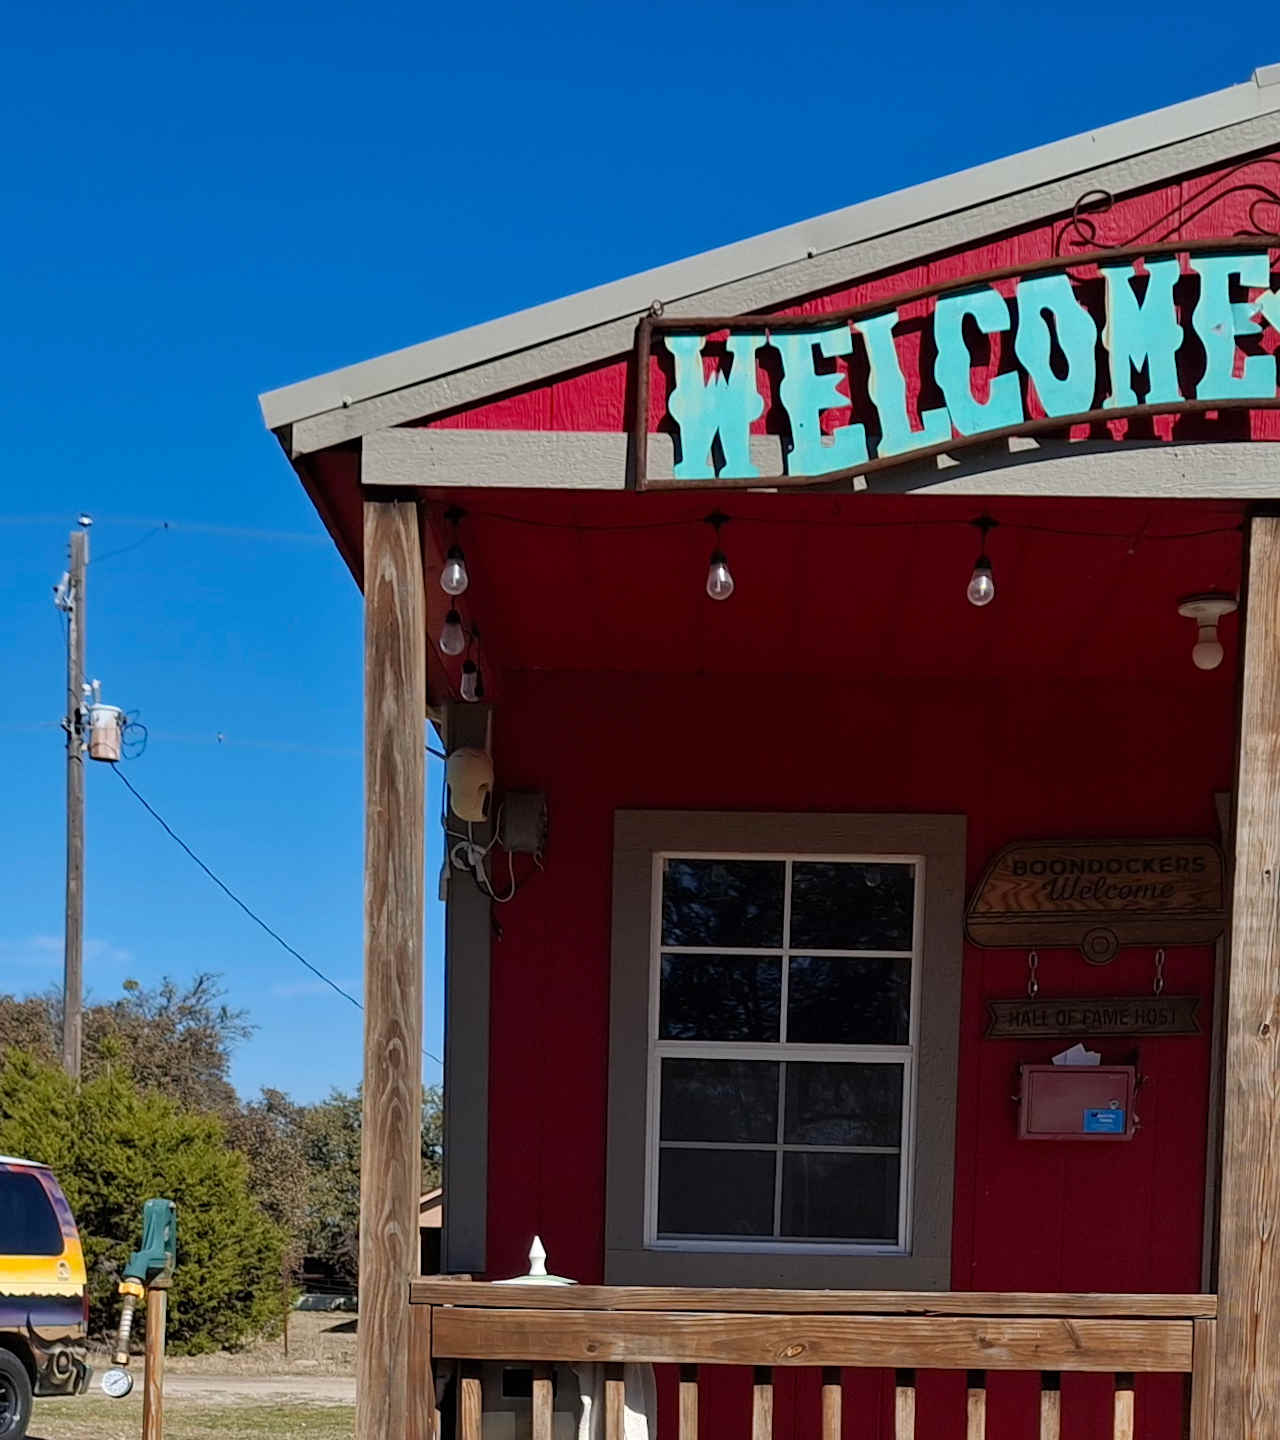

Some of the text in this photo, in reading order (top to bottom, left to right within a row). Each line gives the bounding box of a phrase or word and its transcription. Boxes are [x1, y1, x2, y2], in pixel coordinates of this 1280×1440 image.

[664, 254, 1277, 480] WELCOME
[1012, 856, 1206, 876] BOONDOCKERS
[1042, 875, 1175, 901] Welcome
[1009, 1006, 1177, 1028] HALL OF FAME HOST
